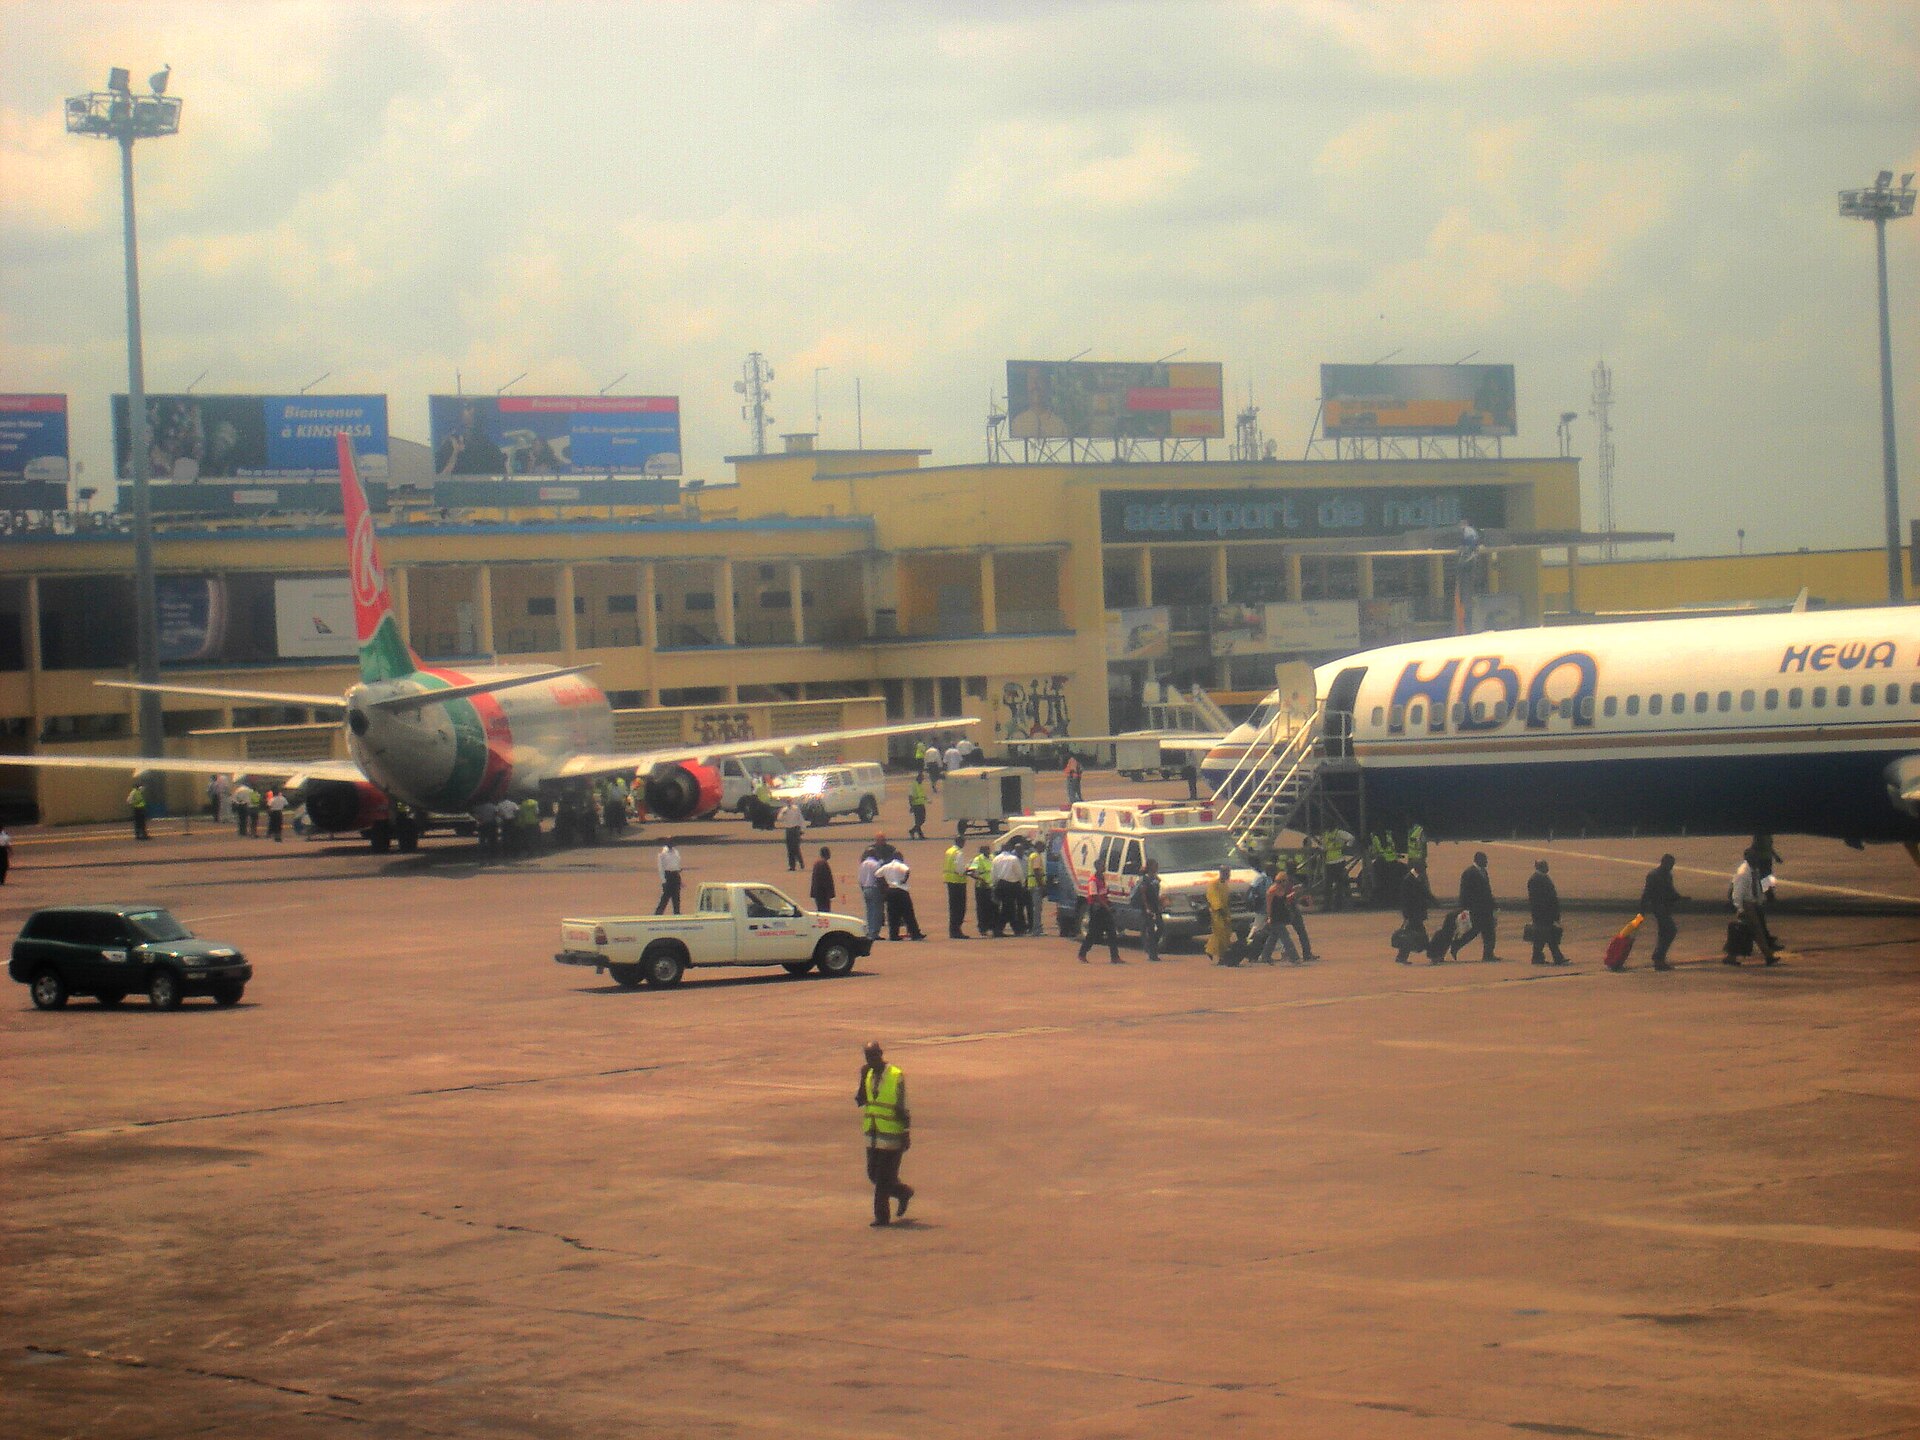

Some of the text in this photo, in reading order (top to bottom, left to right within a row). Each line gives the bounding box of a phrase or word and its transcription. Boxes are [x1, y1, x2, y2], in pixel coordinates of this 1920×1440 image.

[284, 406, 363, 418] Bienvenue
[1124, 499, 1299, 535] aéroport
[1317, 499, 1365, 528] de
[1779, 641, 1896, 673] HEWA
[1387, 651, 1597, 735] HBA
